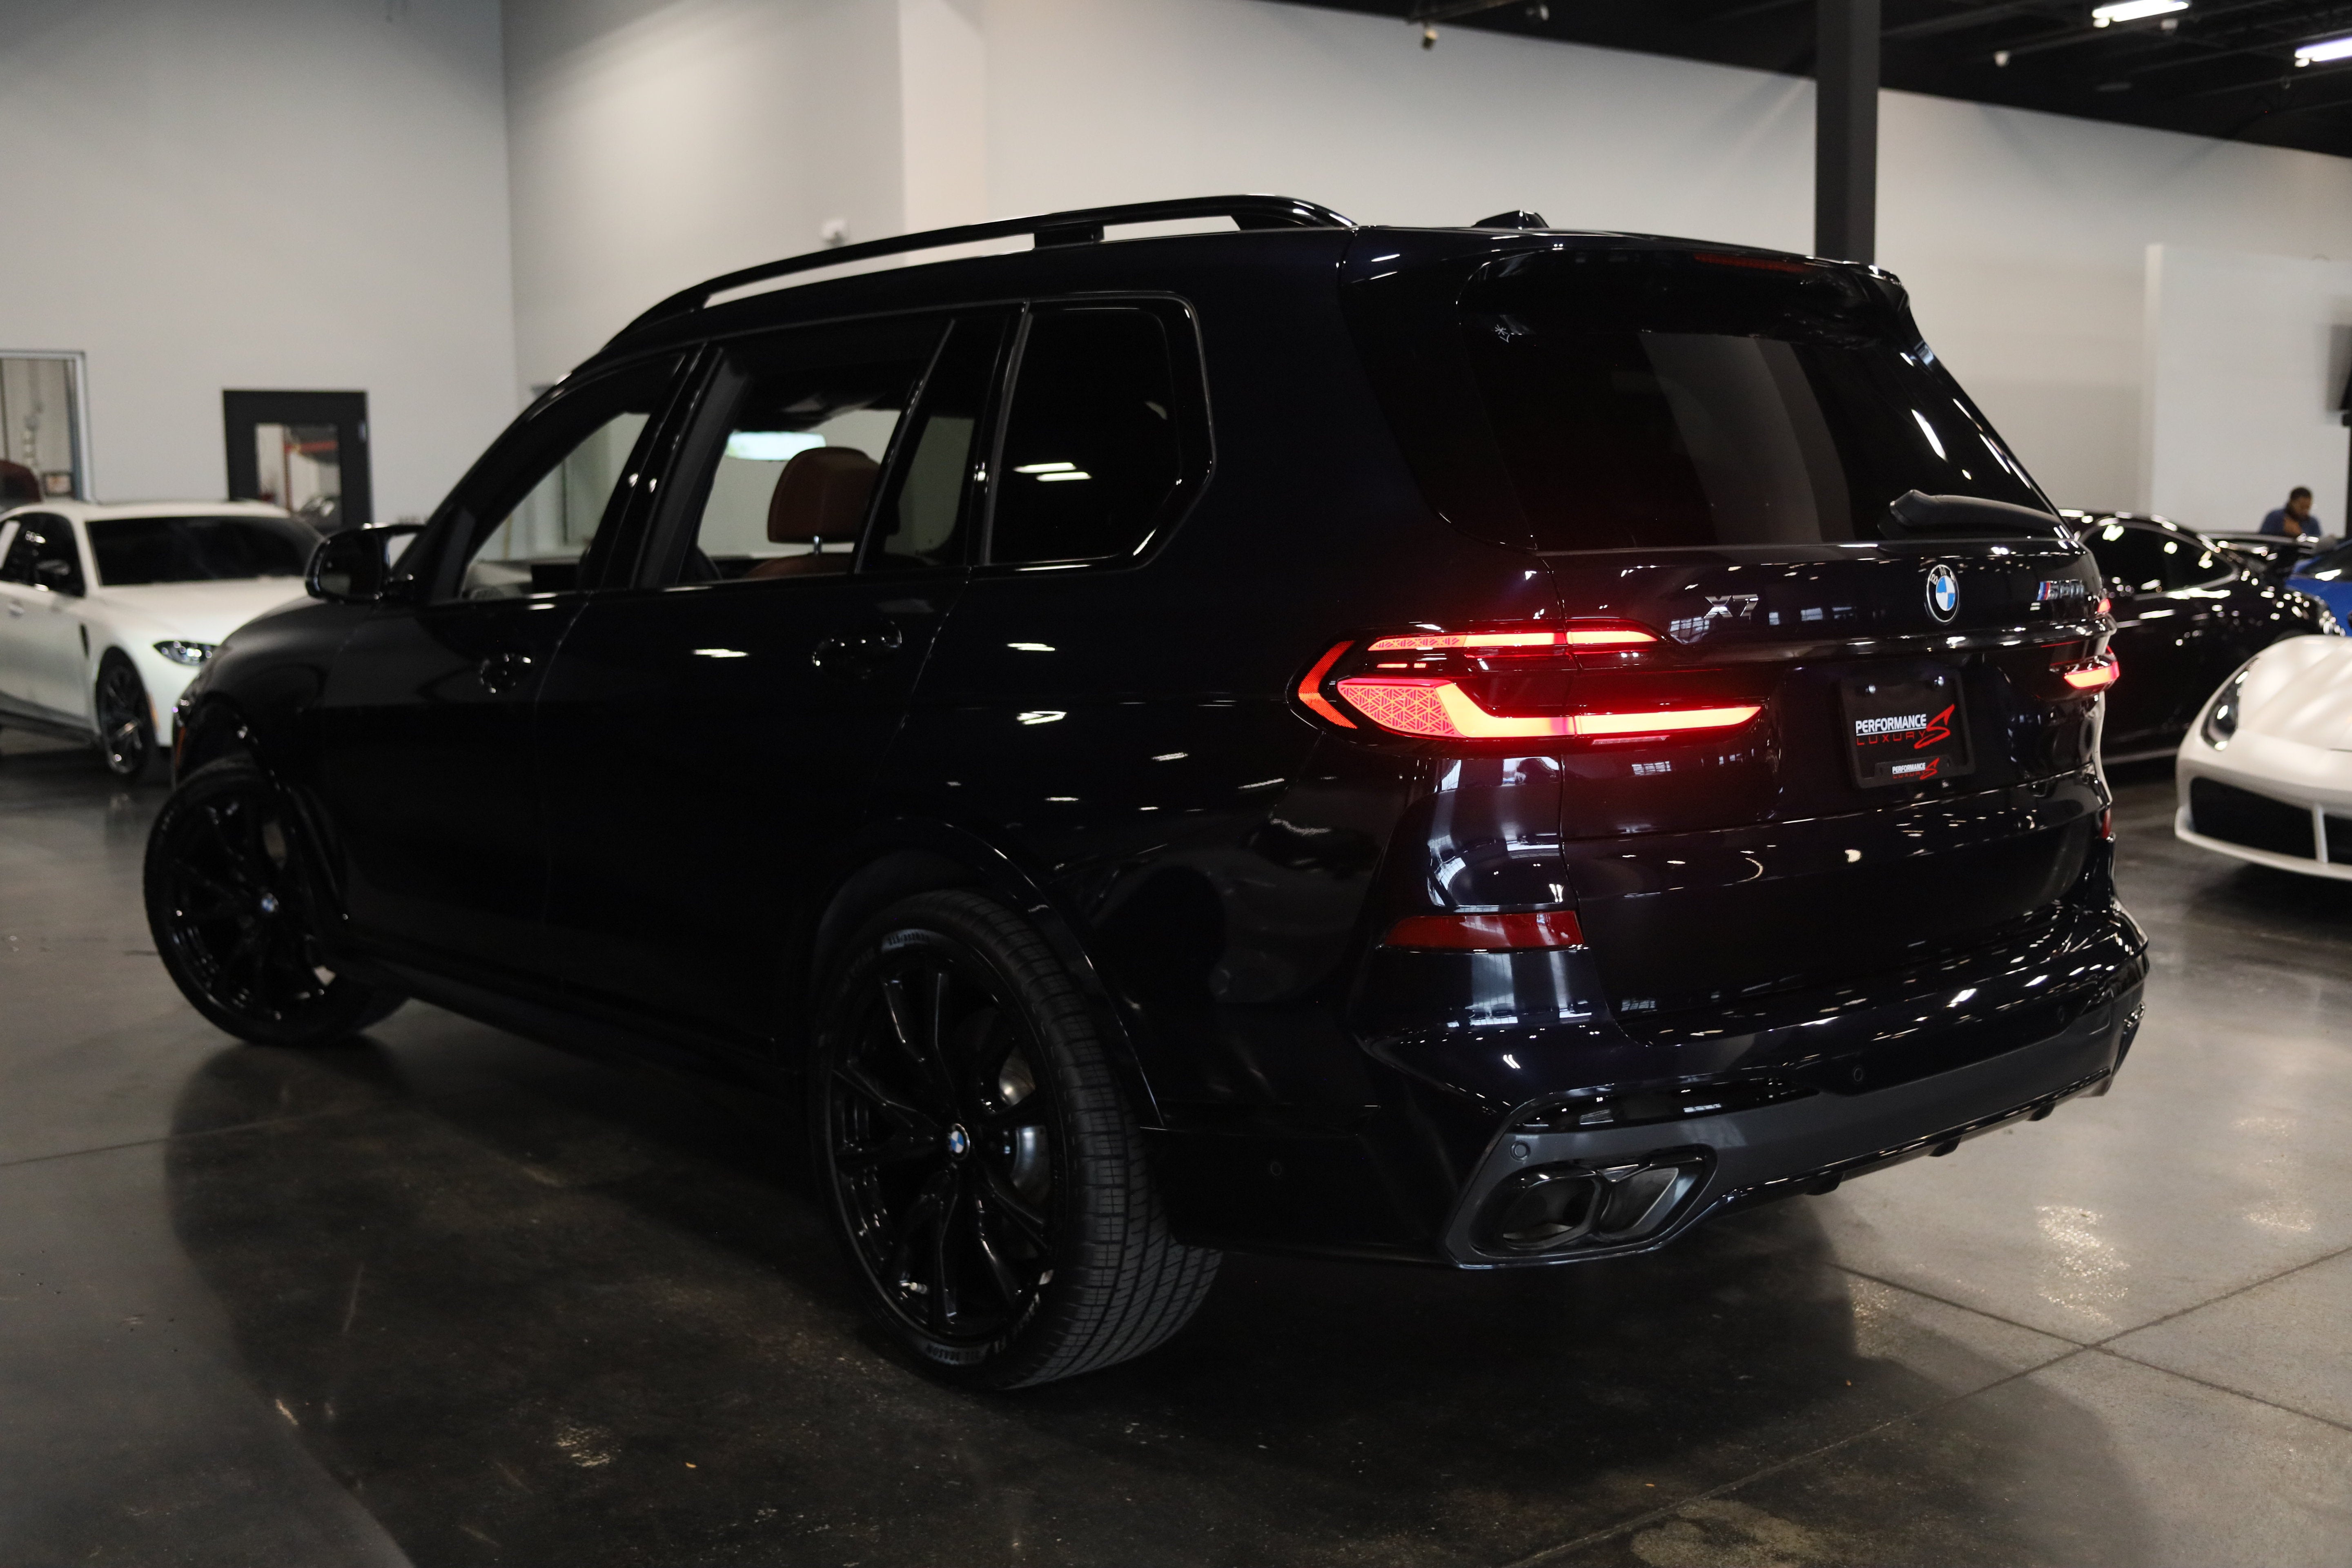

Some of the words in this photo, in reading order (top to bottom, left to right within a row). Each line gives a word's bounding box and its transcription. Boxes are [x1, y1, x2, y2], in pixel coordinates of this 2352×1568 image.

[1703, 594, 1759, 619] X7
[1855, 714, 1927, 734] PERFORMANCE
[1857, 731, 1926, 746] LUXURY
[1892, 762, 1926, 774] PERFORMANCE
